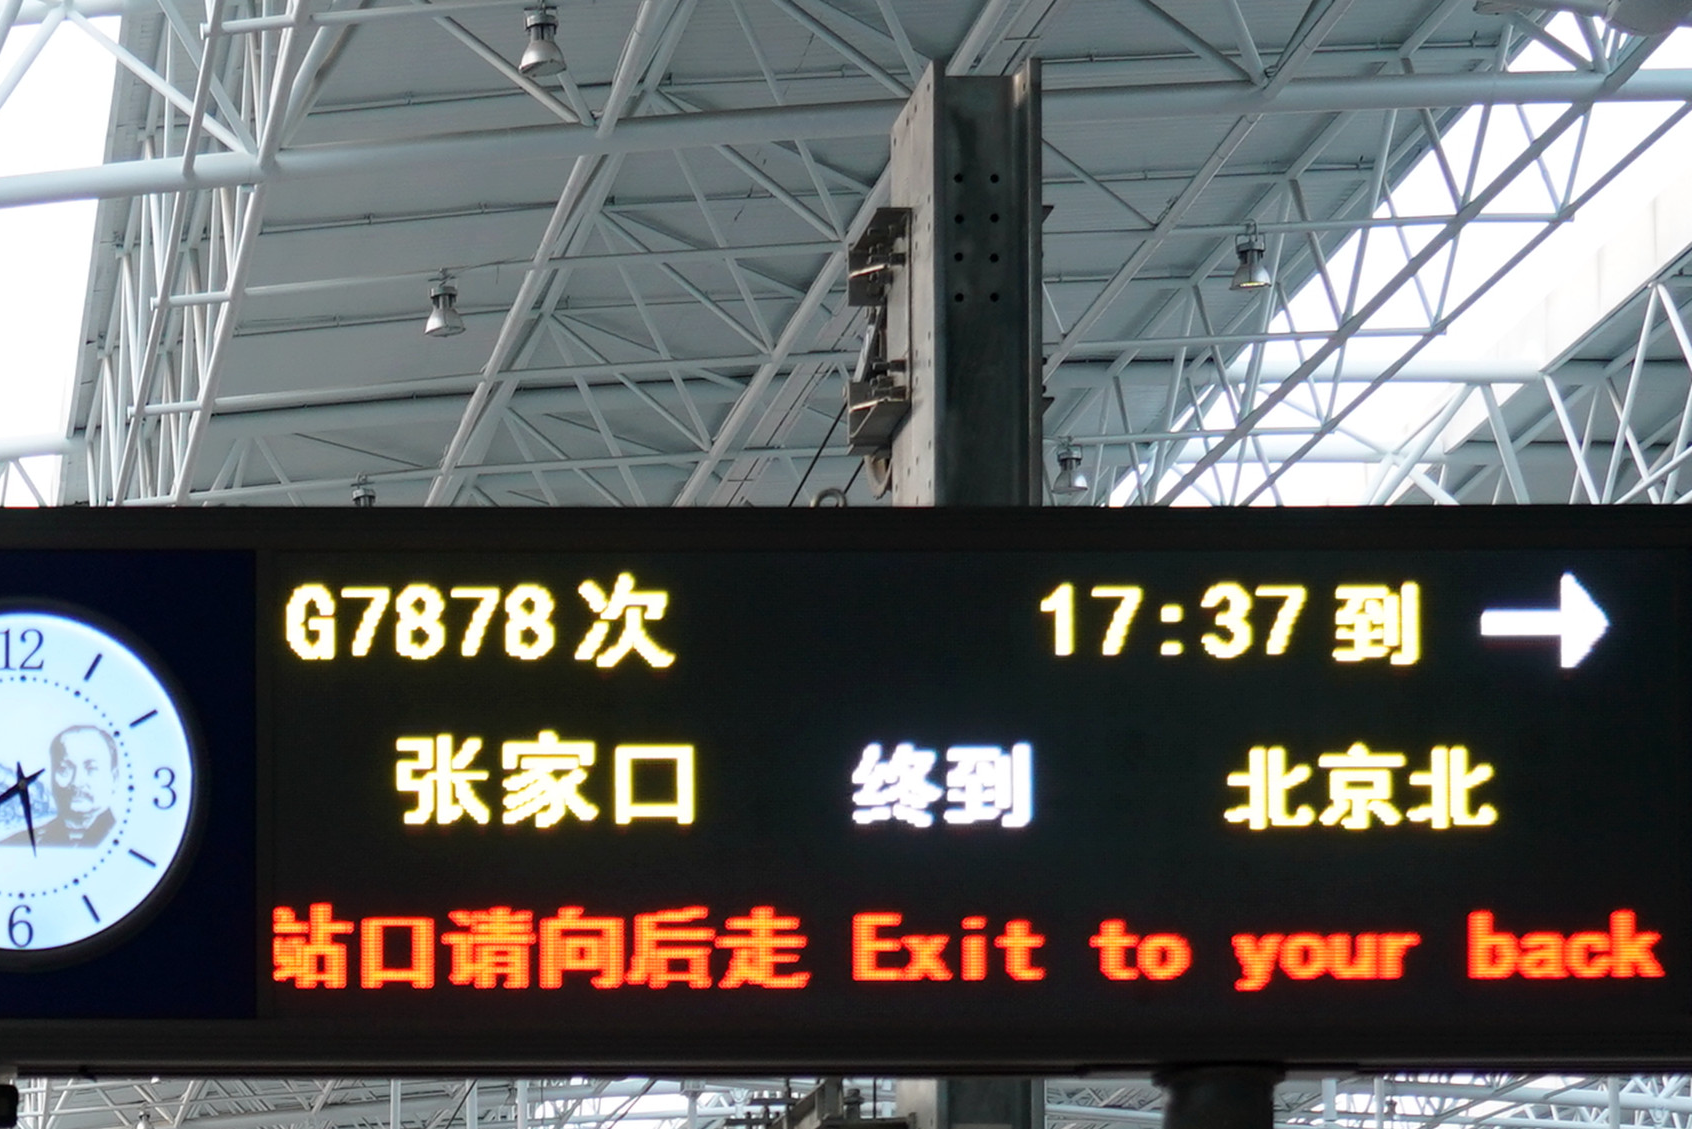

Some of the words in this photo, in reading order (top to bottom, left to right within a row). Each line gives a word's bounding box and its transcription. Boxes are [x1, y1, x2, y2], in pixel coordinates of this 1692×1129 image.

[153, 768, 177, 809] 3
[396, 730, 696, 830] 张家口
[852, 742, 1035, 829] 终到
[1225, 742, 1498, 831] 北京北
[8, 905, 34, 947] 6
[273, 902, 811, 990] 站口请向后走
[853, 912, 1046, 982] Exit
[1090, 919, 1193, 981] to
[1232, 932, 1422, 992] your
[1467, 909, 1666, 981] back
